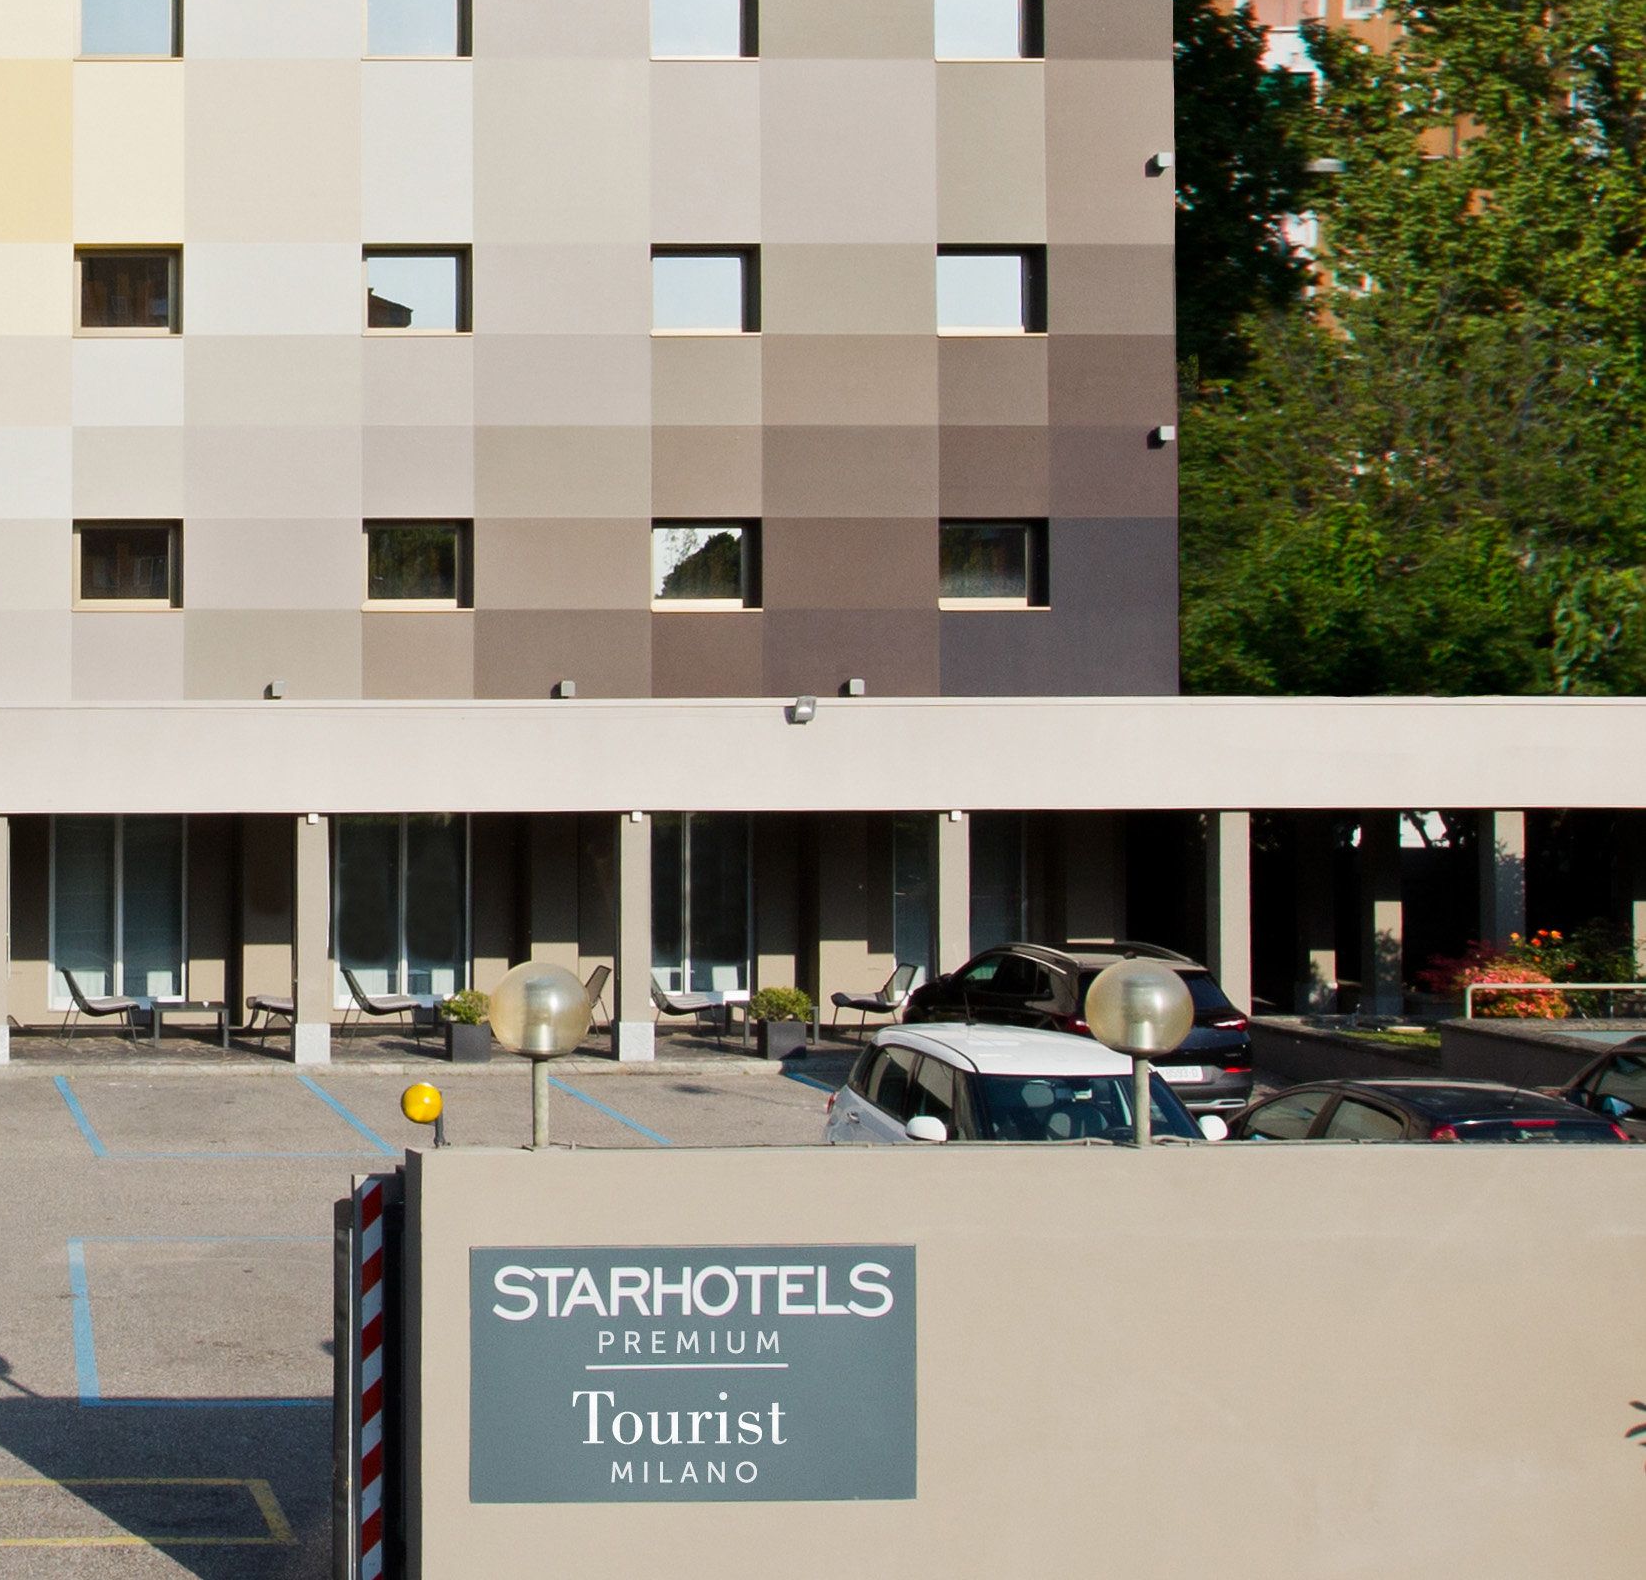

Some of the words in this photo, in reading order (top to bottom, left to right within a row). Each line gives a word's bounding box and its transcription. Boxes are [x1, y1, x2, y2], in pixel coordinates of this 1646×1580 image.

[491, 1262, 894, 1321] STARHOTELS
[598, 1330, 781, 1355] PREMIUM
[572, 1390, 788, 1446] Tourist
[610, 1460, 759, 1484] MILANO
